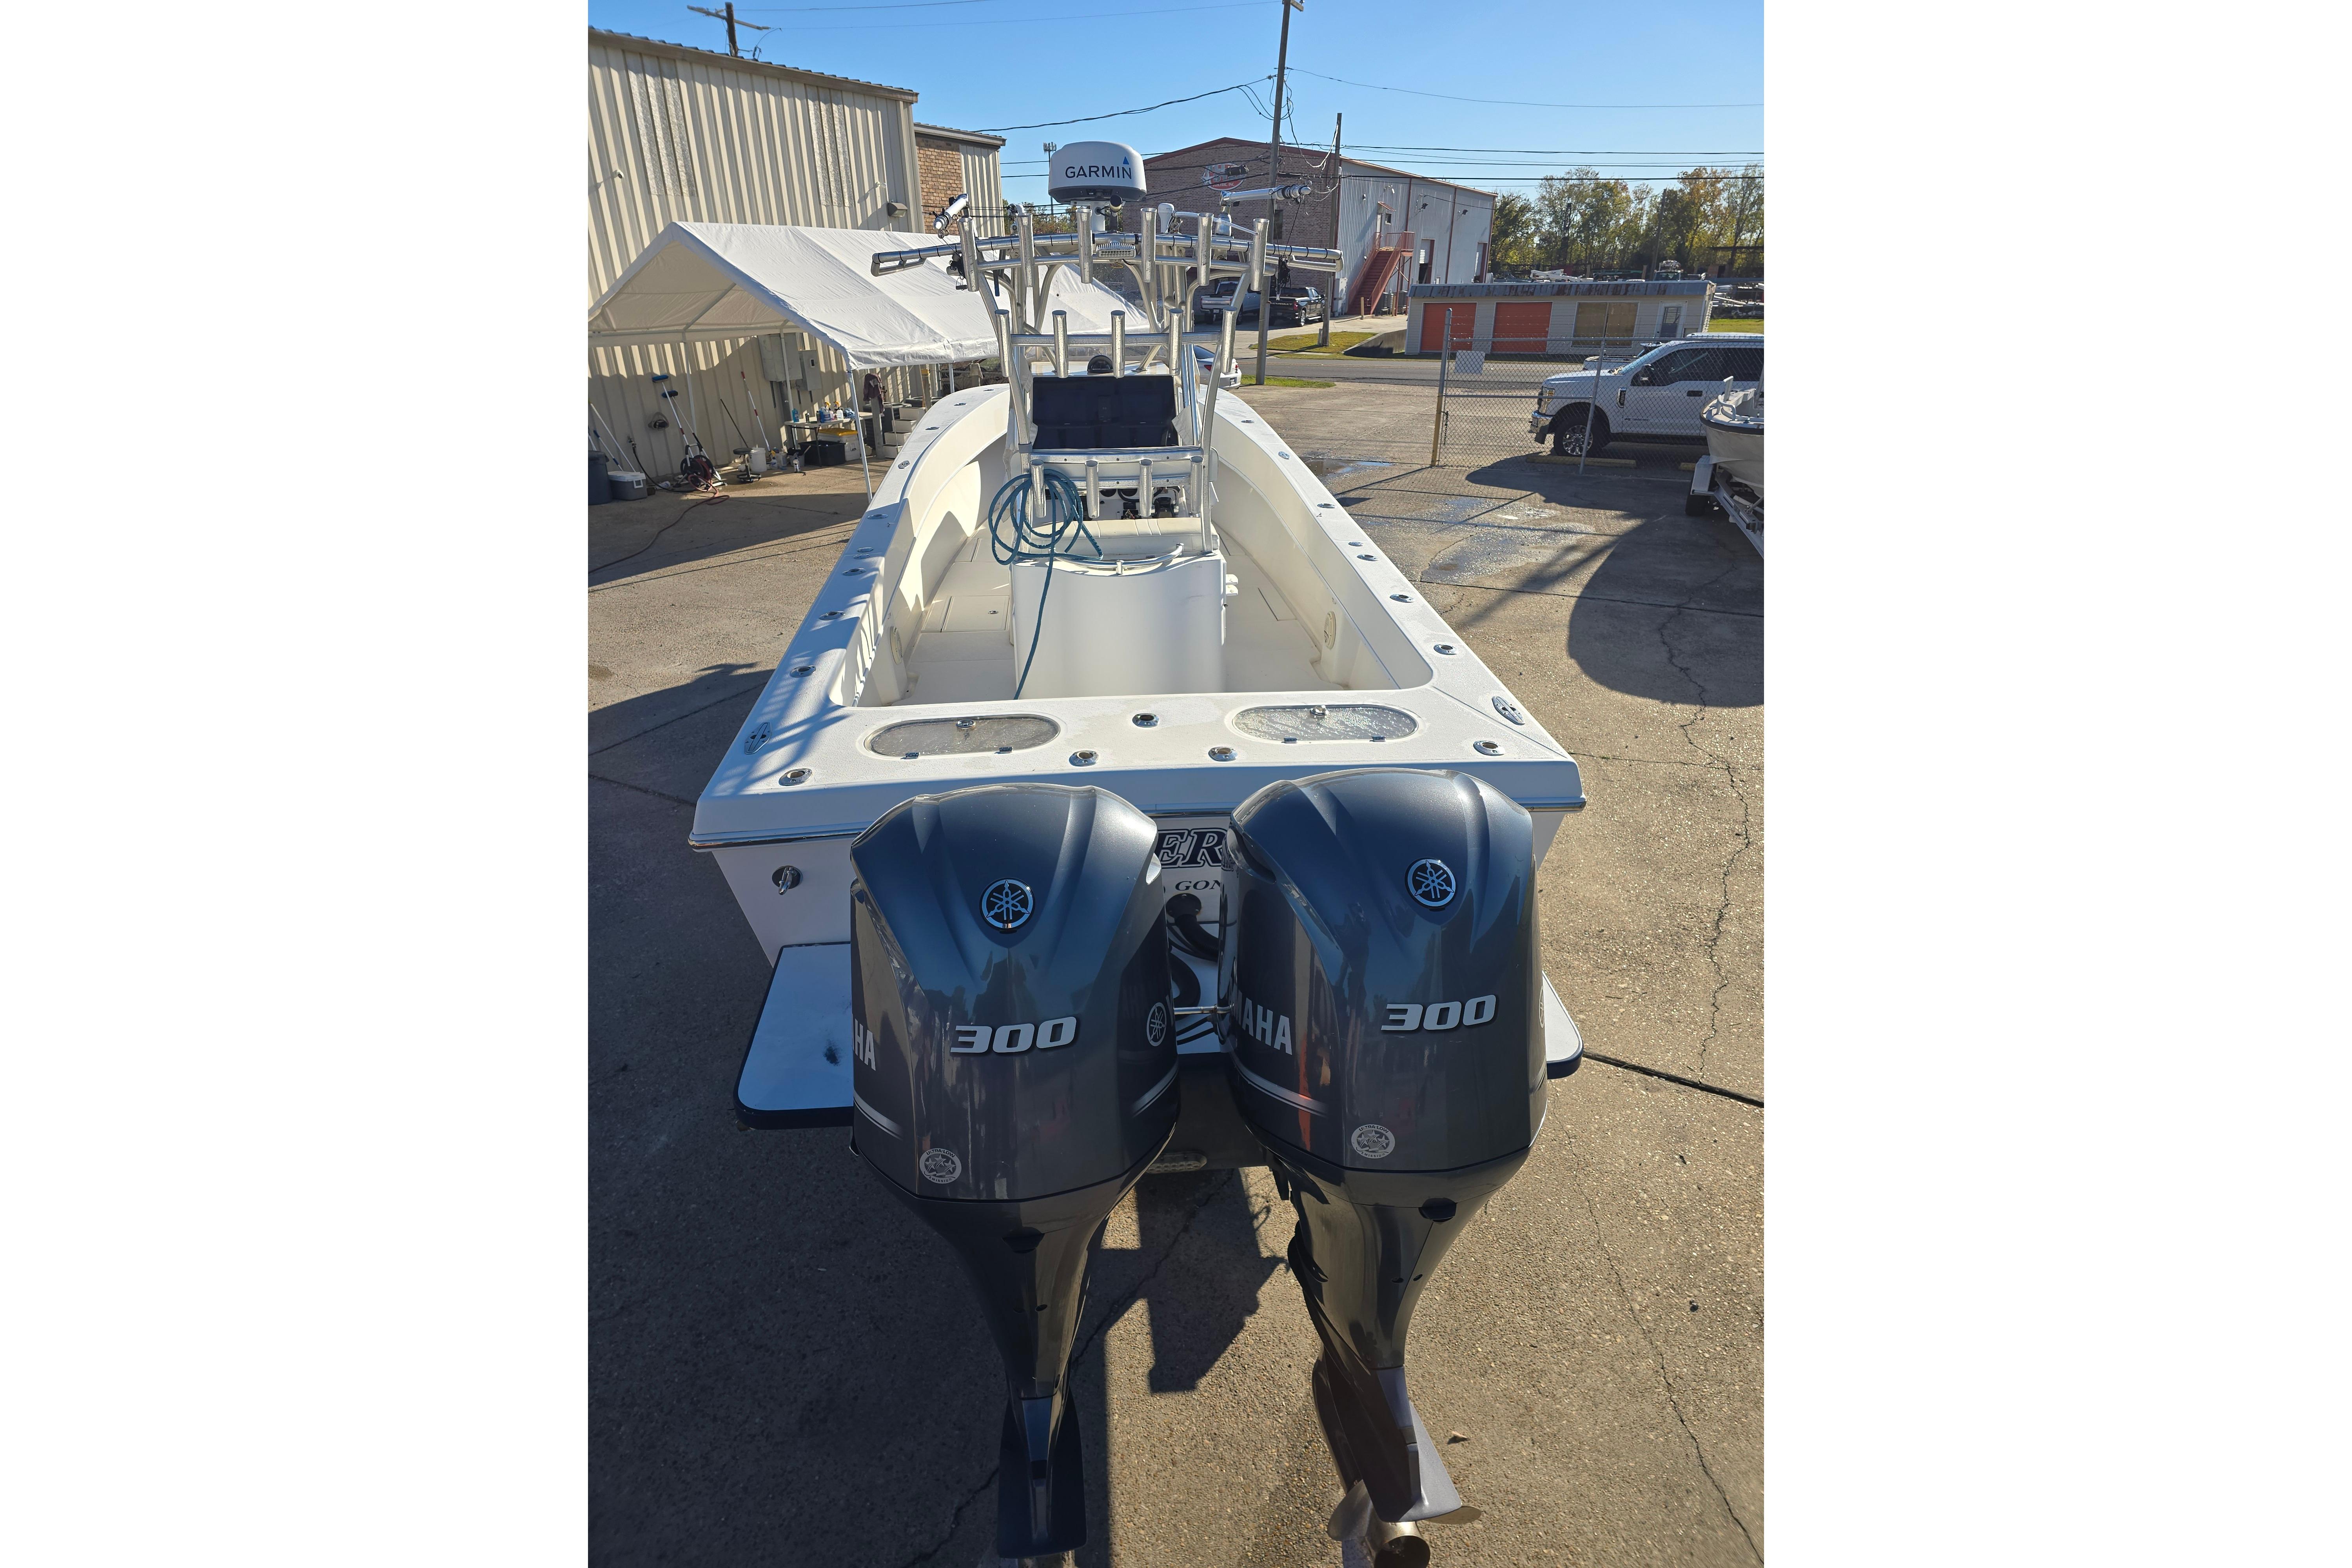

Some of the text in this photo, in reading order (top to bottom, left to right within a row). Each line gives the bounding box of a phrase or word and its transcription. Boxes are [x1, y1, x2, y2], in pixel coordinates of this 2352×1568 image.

[1065, 165, 1132, 179] GARMIN
[1381, 995, 1496, 1031] 300
[950, 1016, 1077, 1053] 300
